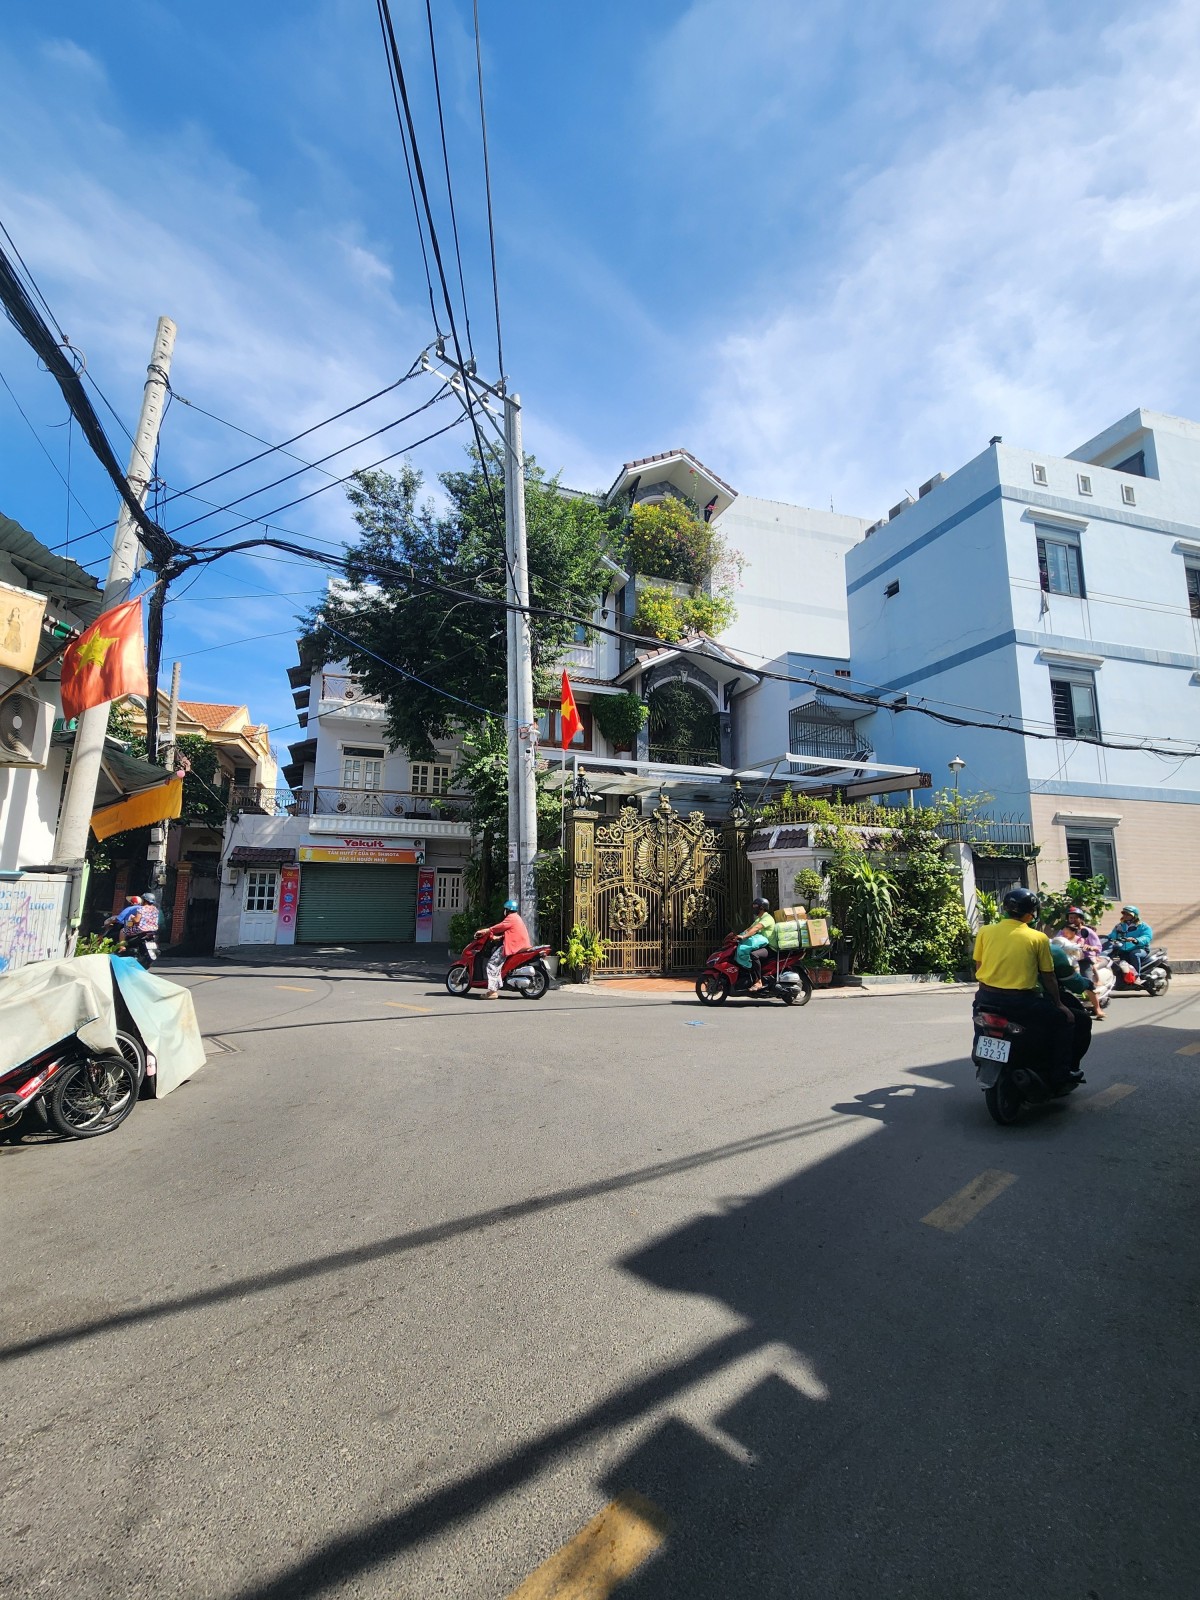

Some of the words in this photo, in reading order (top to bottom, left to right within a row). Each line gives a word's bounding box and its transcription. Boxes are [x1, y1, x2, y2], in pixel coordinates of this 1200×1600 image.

[344, 840, 384, 848] Yakult
[983, 1038, 1006, 1051] 59-T2
[979, 1046, 1006, 1061] 132.31
